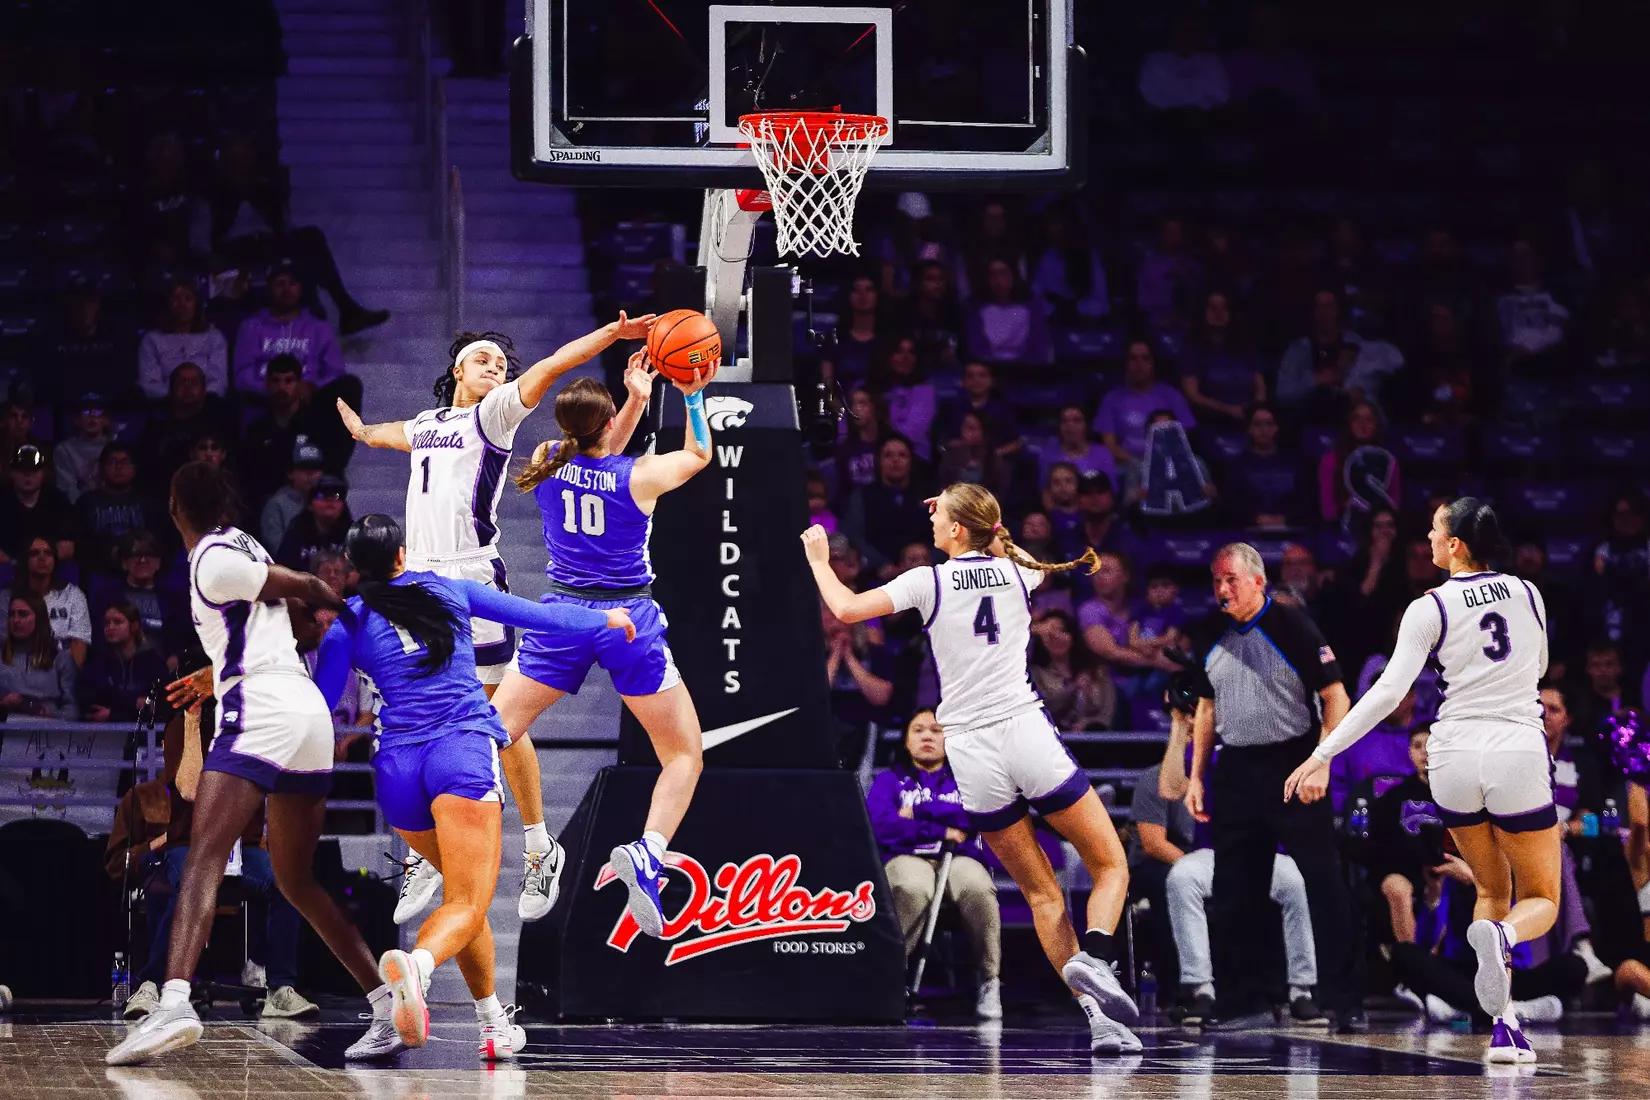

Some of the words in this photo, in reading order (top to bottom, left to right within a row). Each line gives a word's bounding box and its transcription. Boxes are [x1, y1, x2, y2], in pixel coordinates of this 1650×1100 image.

[549, 150, 601, 162] SPALDING
[688, 343, 720, 365] ELITE
[420, 455, 430, 494] 1
[560, 488, 606, 537] 10
[716, 445, 744, 694] WILDCATS
[952, 567, 1011, 591] SUNDELL
[1462, 581, 1512, 608] GLENN
[972, 595, 1001, 646] 4
[1479, 611, 1512, 663] 3
[593, 850, 876, 953] Dillons
[773, 941, 809, 954] FOOD
